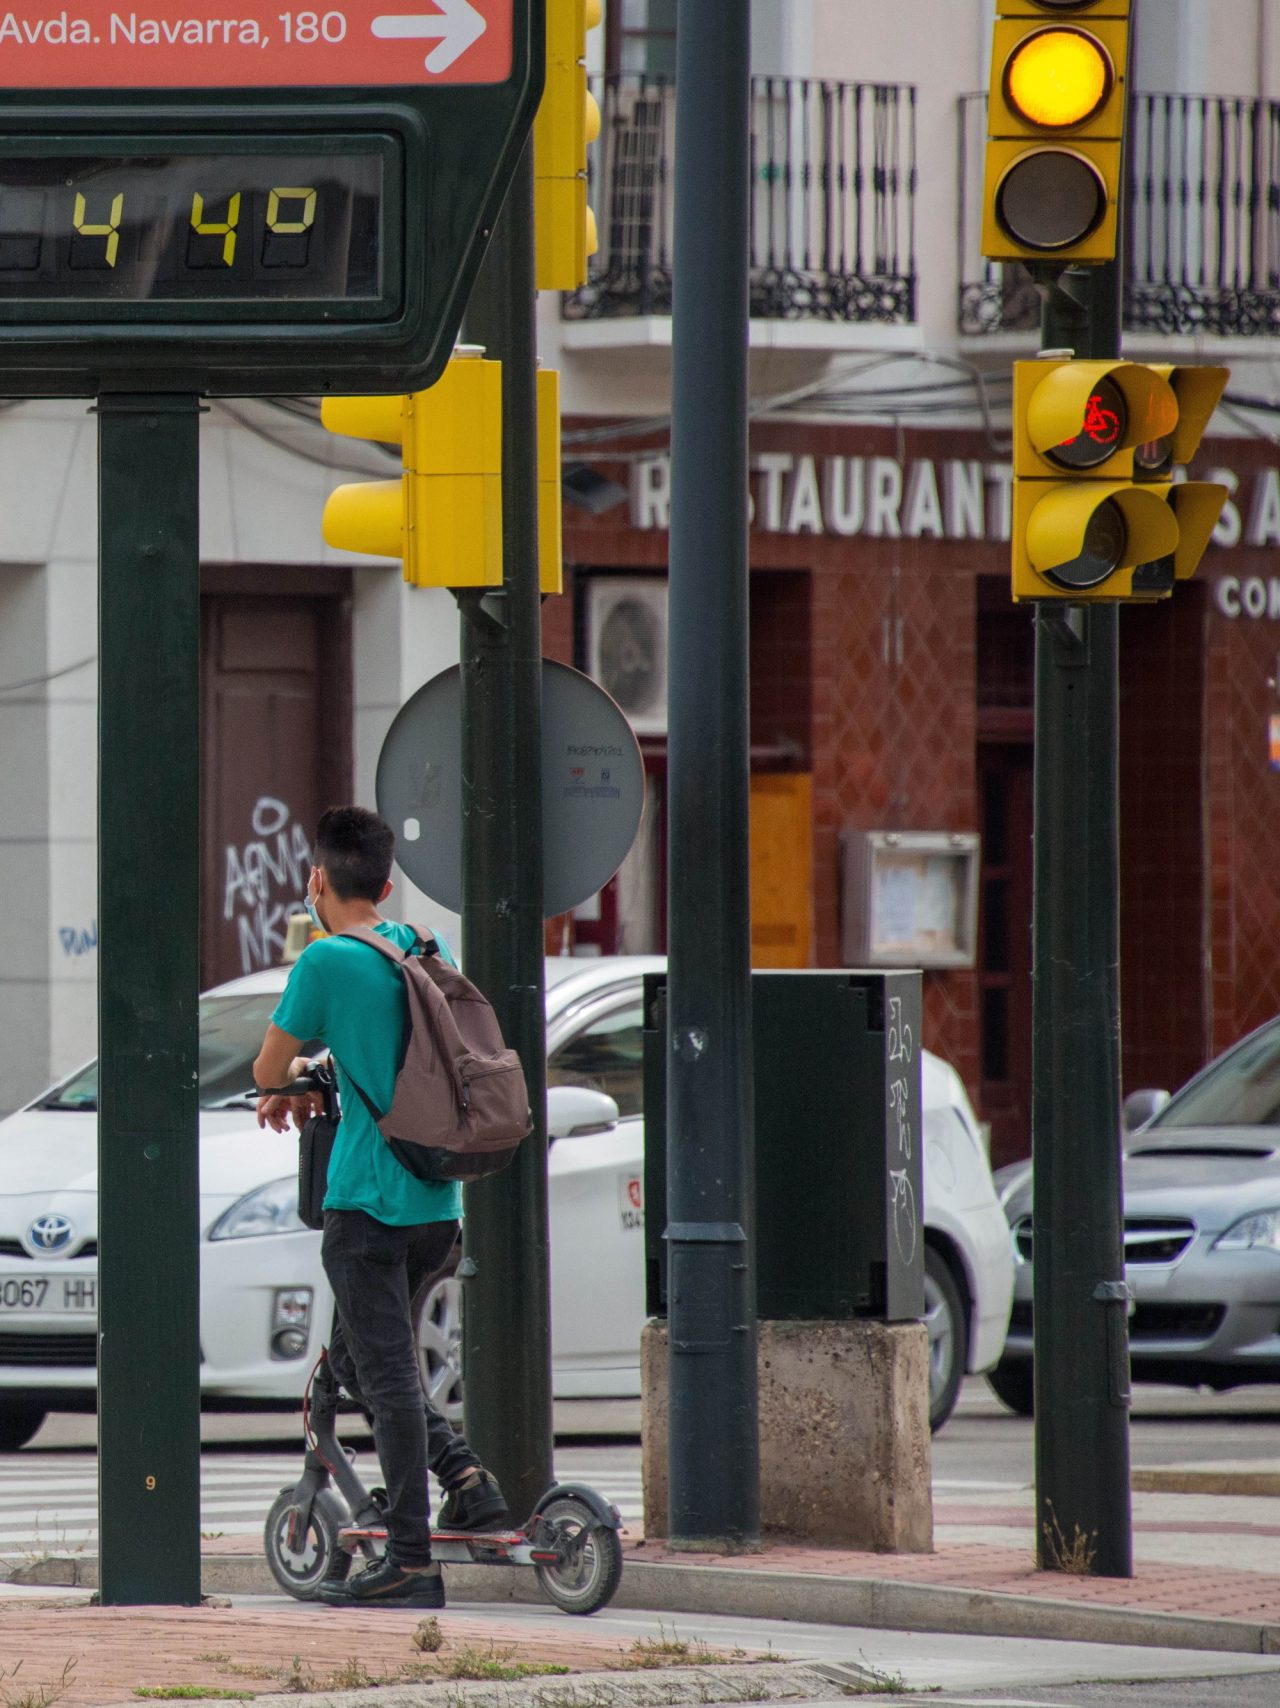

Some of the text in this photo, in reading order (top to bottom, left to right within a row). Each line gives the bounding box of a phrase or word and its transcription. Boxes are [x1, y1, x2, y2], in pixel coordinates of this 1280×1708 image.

[109, 12, 271, 49] Navarra,
[279, 11, 348, 44] 180
[146, 1474, 156, 1490] 9
